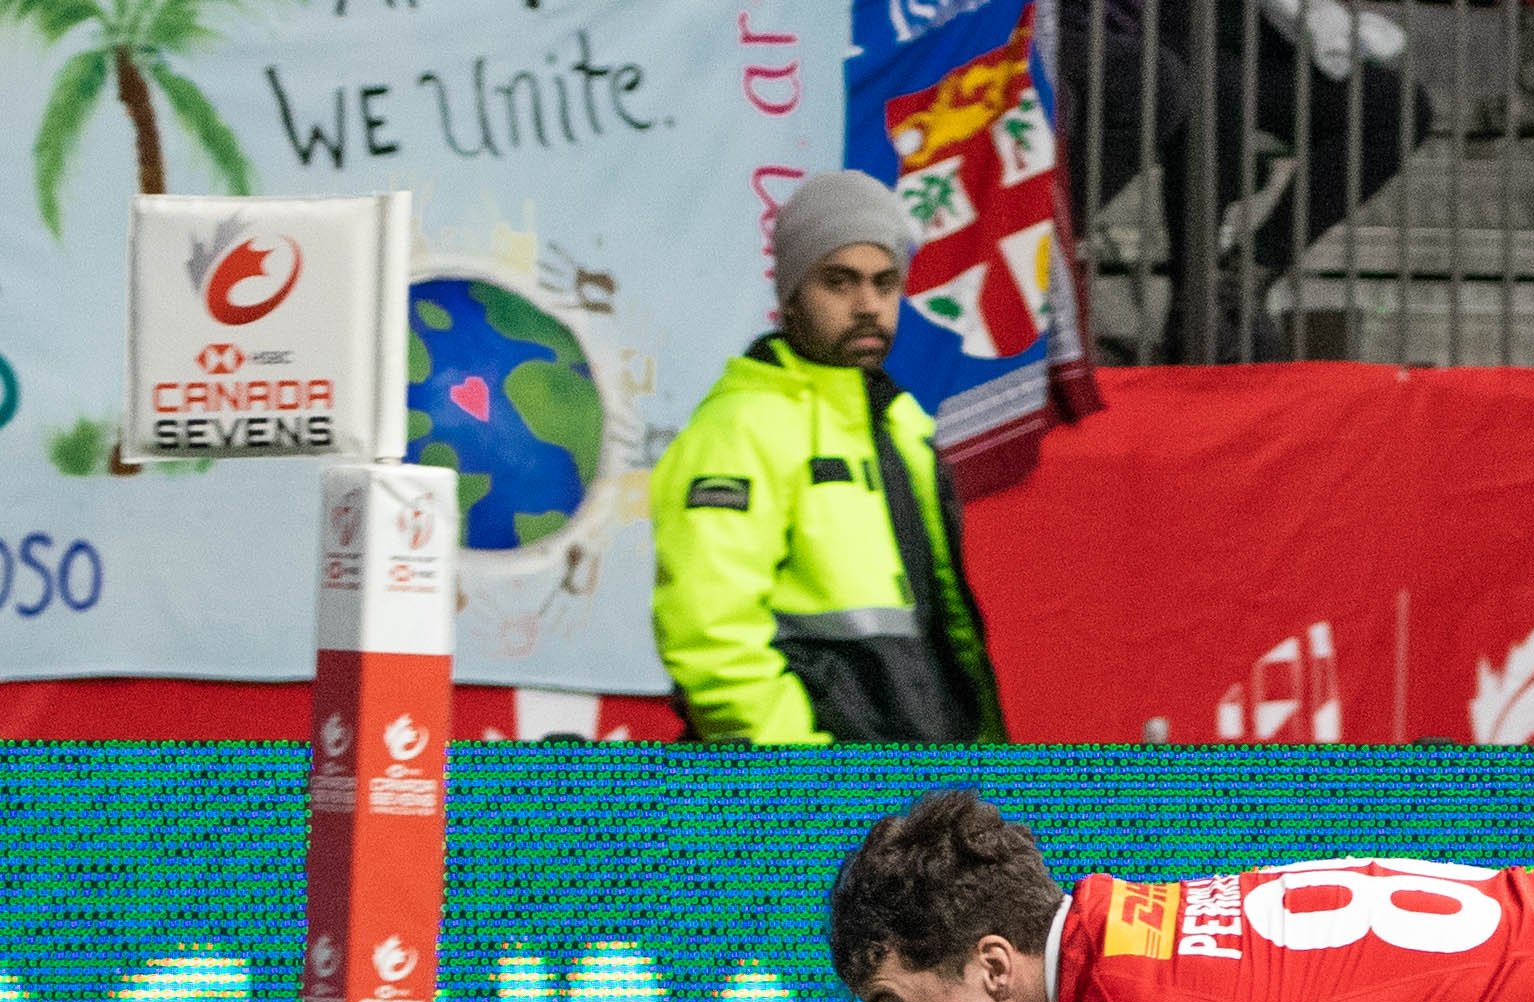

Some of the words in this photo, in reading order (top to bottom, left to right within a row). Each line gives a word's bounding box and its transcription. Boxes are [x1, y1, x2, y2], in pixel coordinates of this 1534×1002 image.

[265, 65, 400, 169] WE
[153, 379, 334, 413] CANADA
[156, 416, 333, 449] SEVENS
